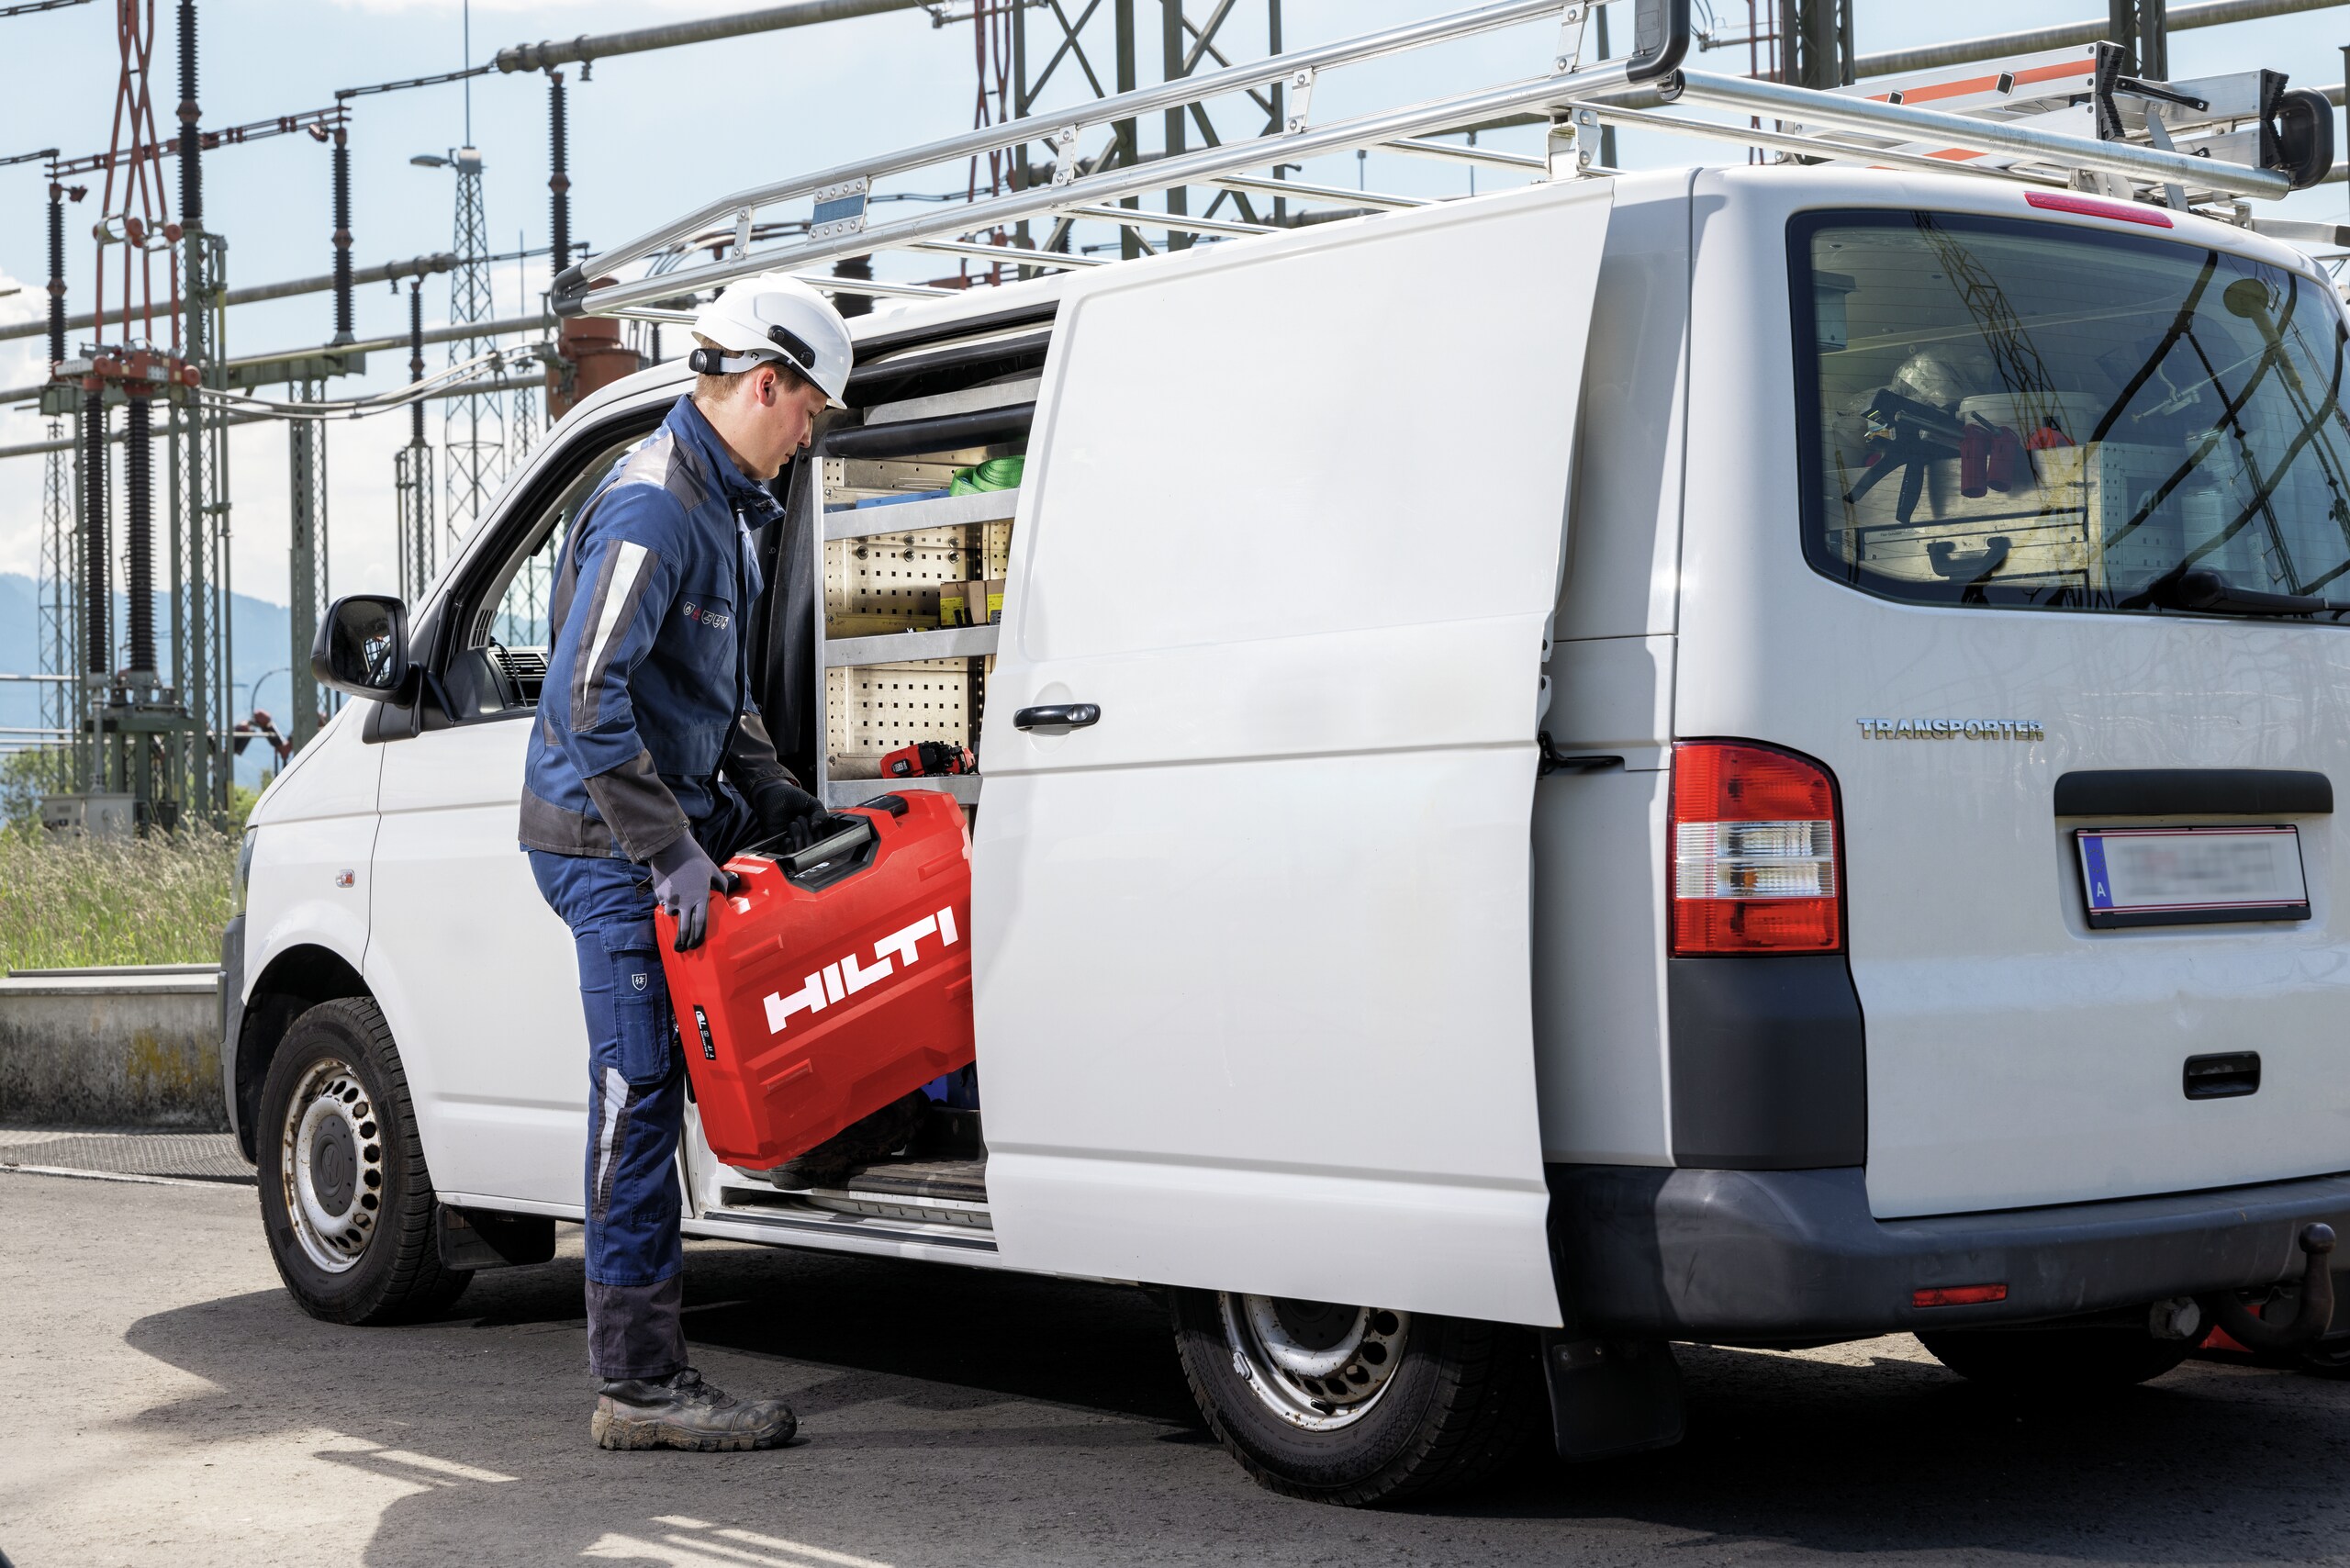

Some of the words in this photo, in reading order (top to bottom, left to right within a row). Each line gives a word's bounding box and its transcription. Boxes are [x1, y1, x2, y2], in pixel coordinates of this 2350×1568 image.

[1857, 718, 2044, 741] TRANSPORTER
[2097, 881, 2107, 897] A
[763, 905, 959, 1036] HILTI
